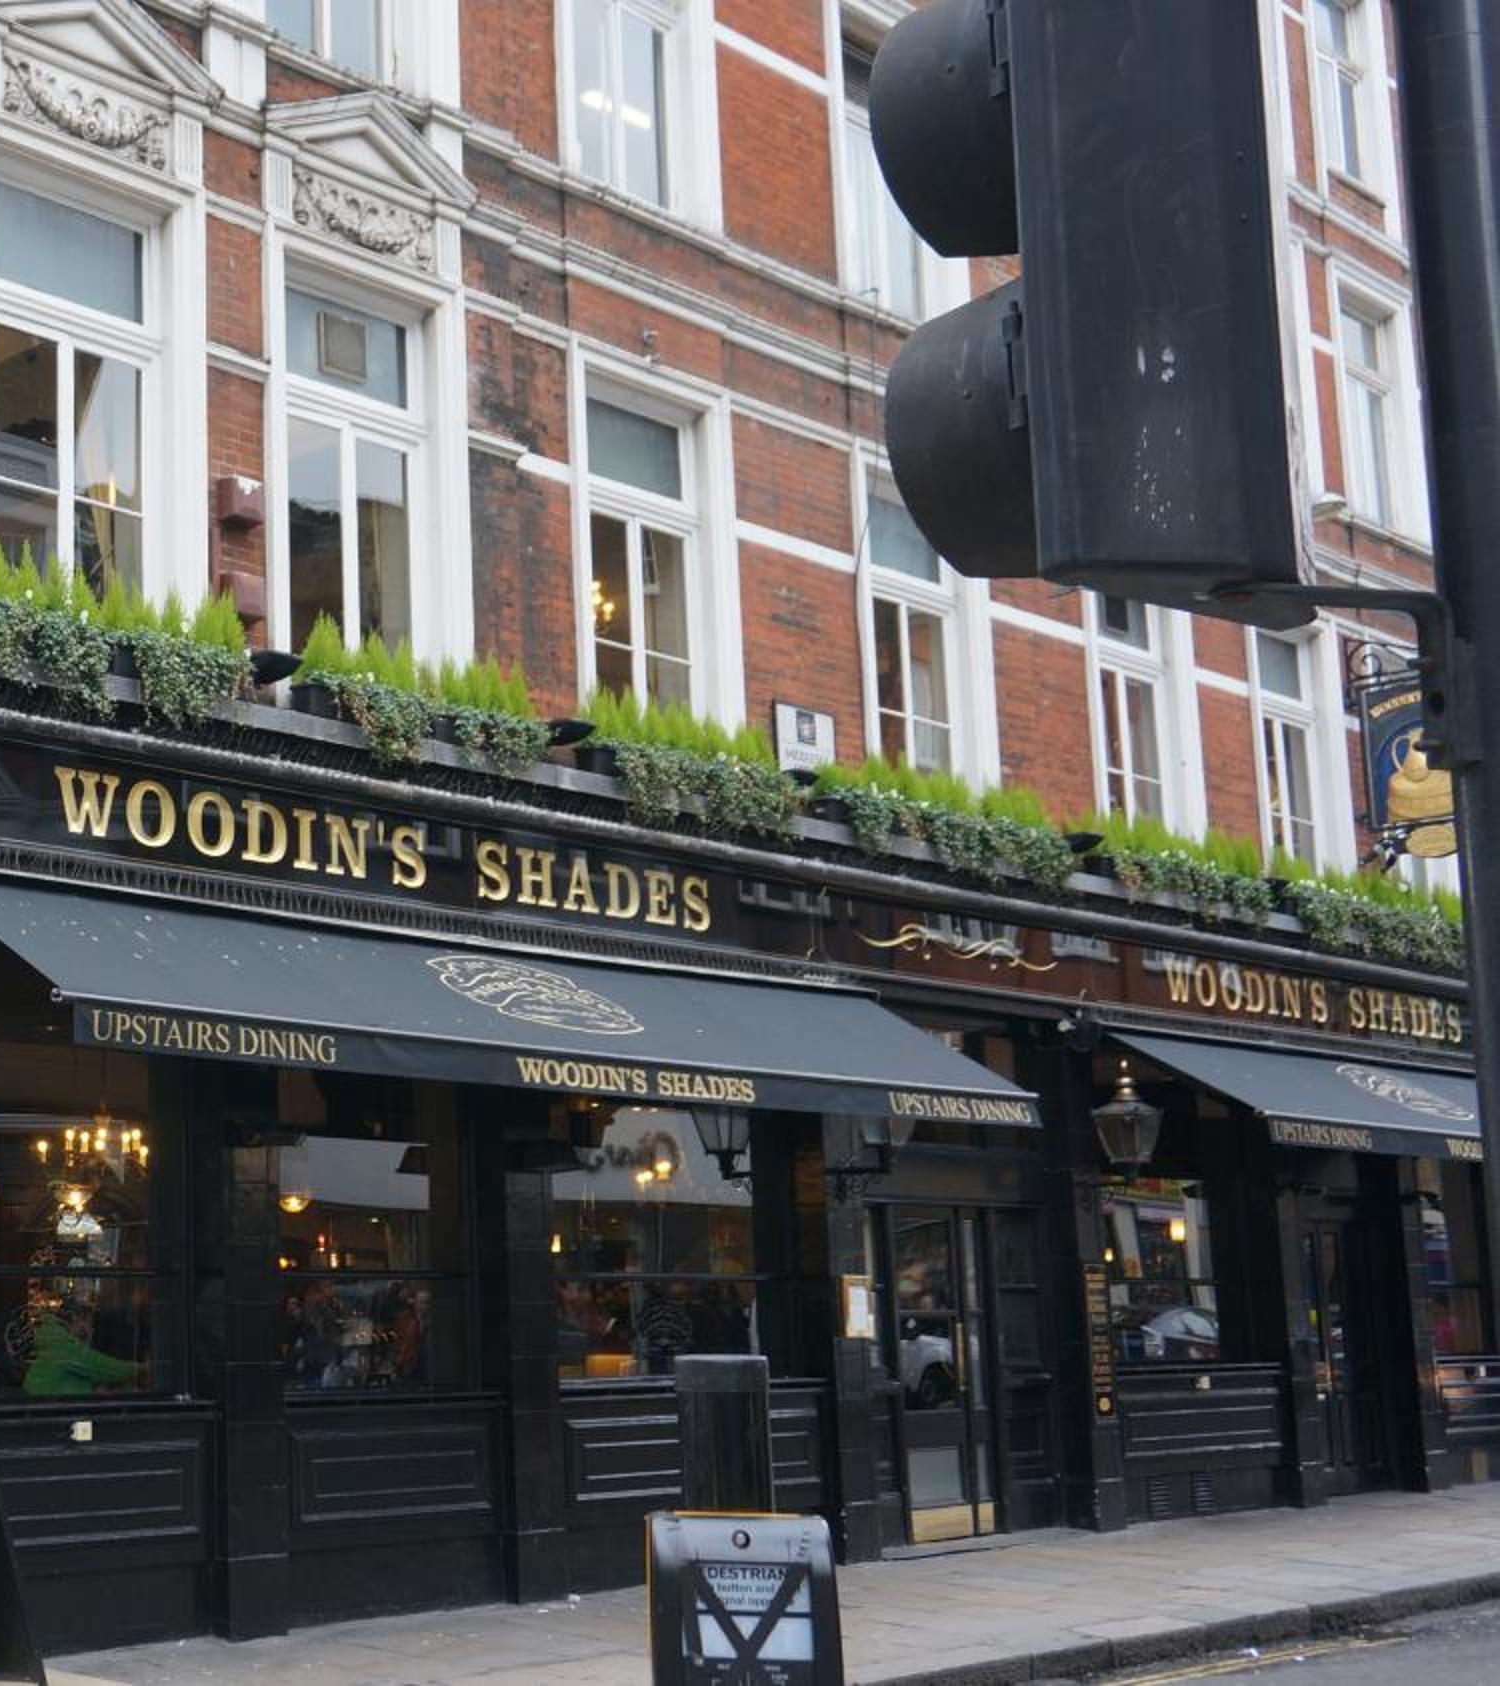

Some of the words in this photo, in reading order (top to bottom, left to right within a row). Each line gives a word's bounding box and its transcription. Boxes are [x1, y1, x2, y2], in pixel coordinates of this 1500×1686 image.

[54, 766, 428, 889] WOODIN'S
[476, 839, 712, 932] SHADES
[1164, 957, 1329, 1024] WOODIN'S
[1349, 986, 1462, 1043] SHADES
[91, 1009, 231, 1055] UPSTAIRS
[237, 1025, 338, 1065] DINING
[515, 1056, 647, 1095] WOODIN'S
[657, 1073, 756, 1103] SHADES
[888, 1091, 971, 1119] UPSTAIRS
[973, 1101, 1032, 1124] DINING
[1270, 1120, 1331, 1146] UPSTAIRS
[1331, 1126, 1373, 1149] DINING
[707, 1567, 791, 1580] DESTRIAN
